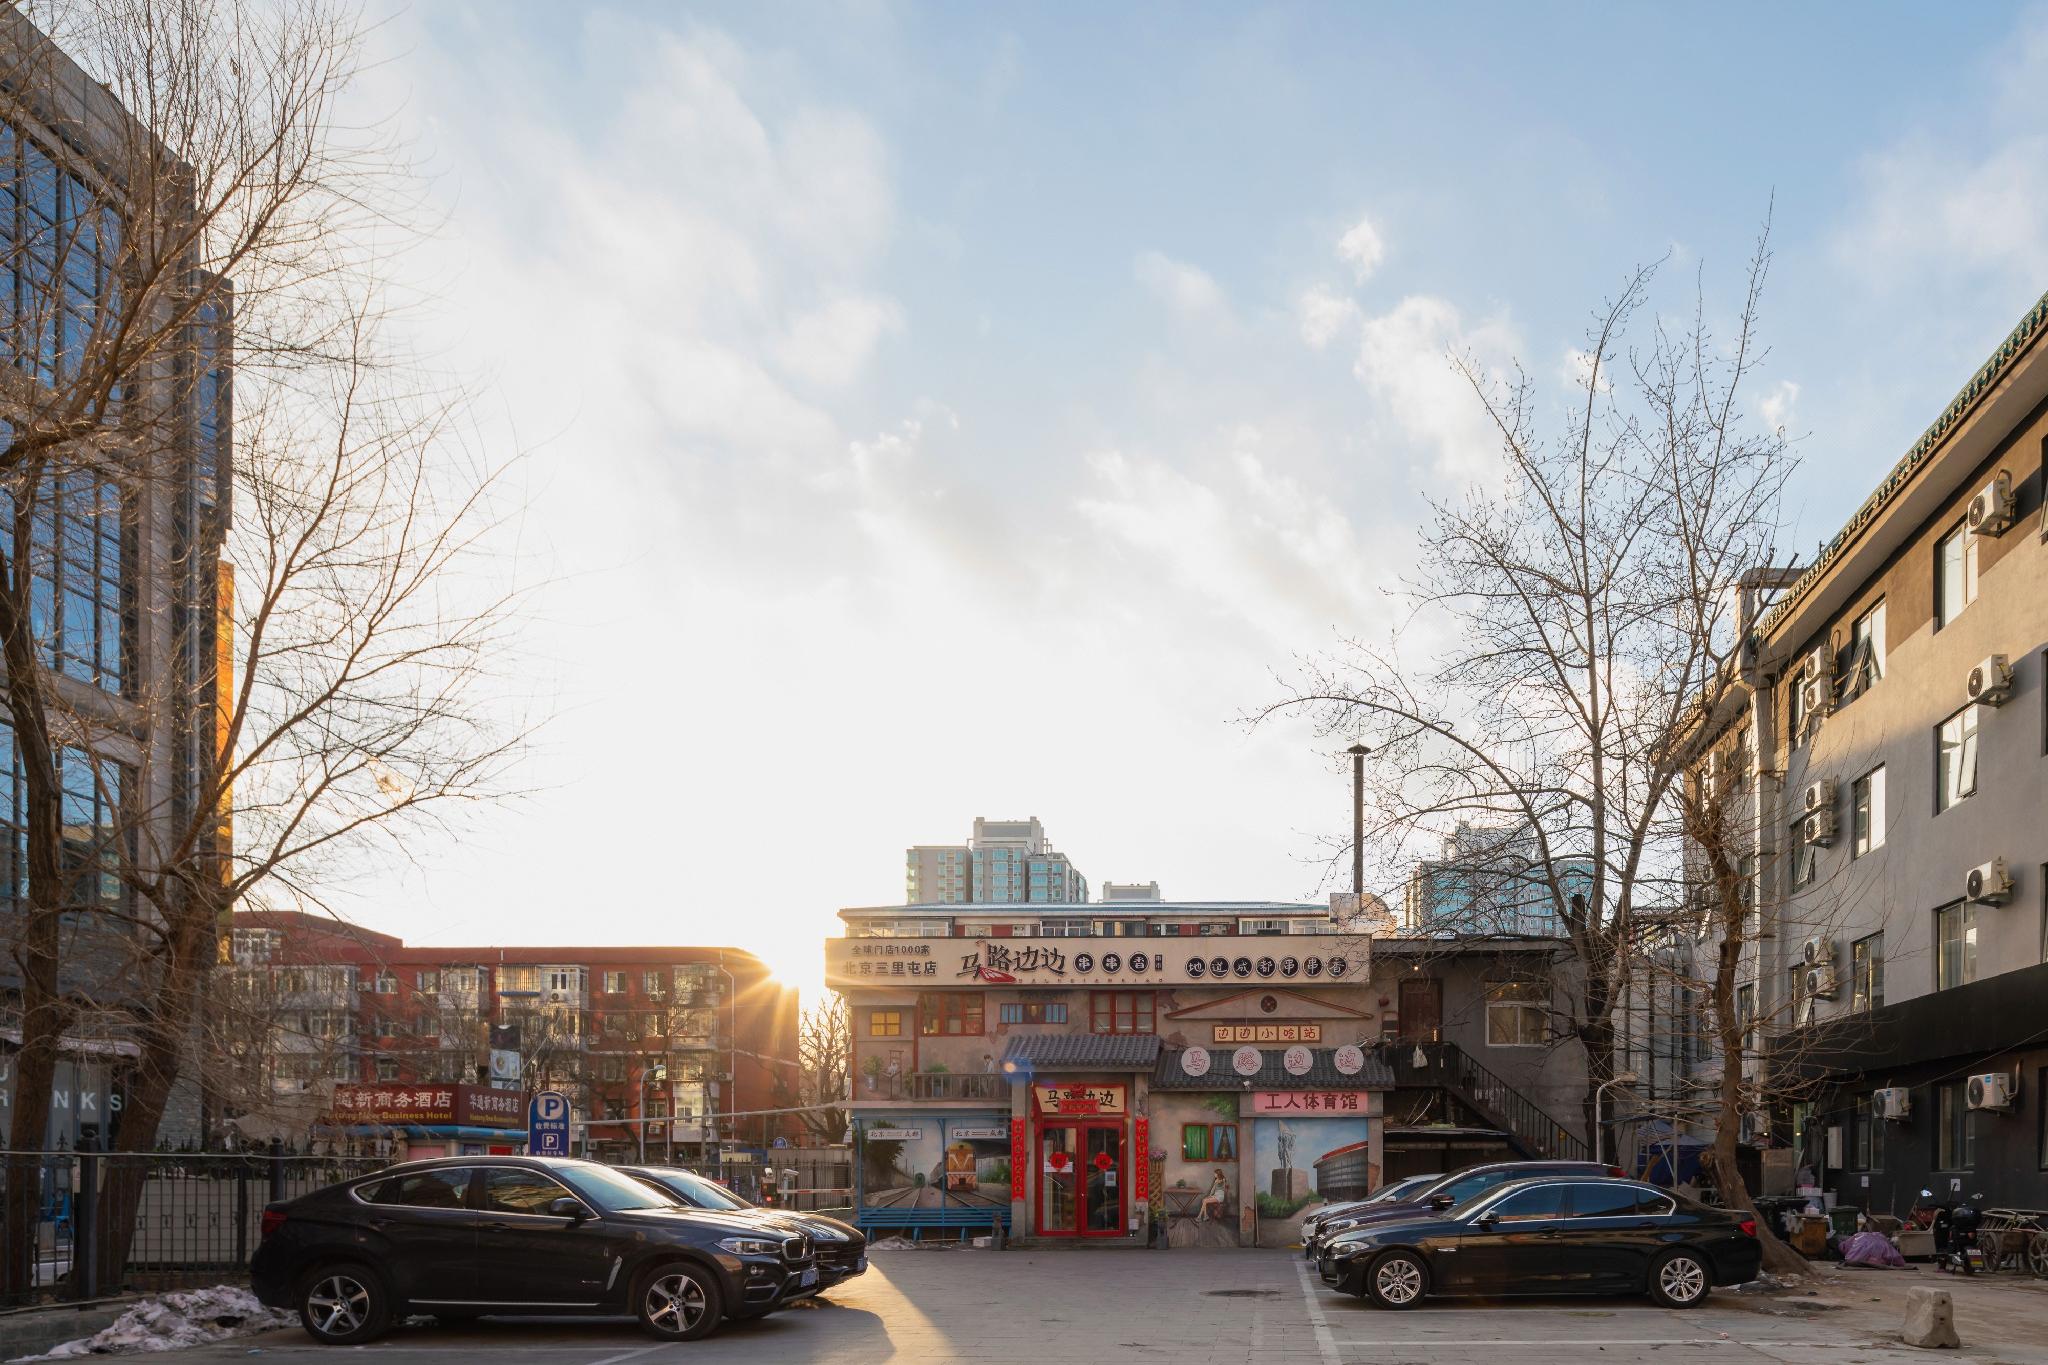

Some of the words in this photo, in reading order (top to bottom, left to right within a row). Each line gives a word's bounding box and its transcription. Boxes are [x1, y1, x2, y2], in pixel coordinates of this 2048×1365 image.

[842, 960, 937, 975] 北京三里屯店
[1218, 1027, 1316, 1040] 边边小吃站
[1264, 1093, 1358, 1110] 工人体育馆
[382, 1111, 425, 1120] Business
[427, 1111, 452, 1120] Hotel
